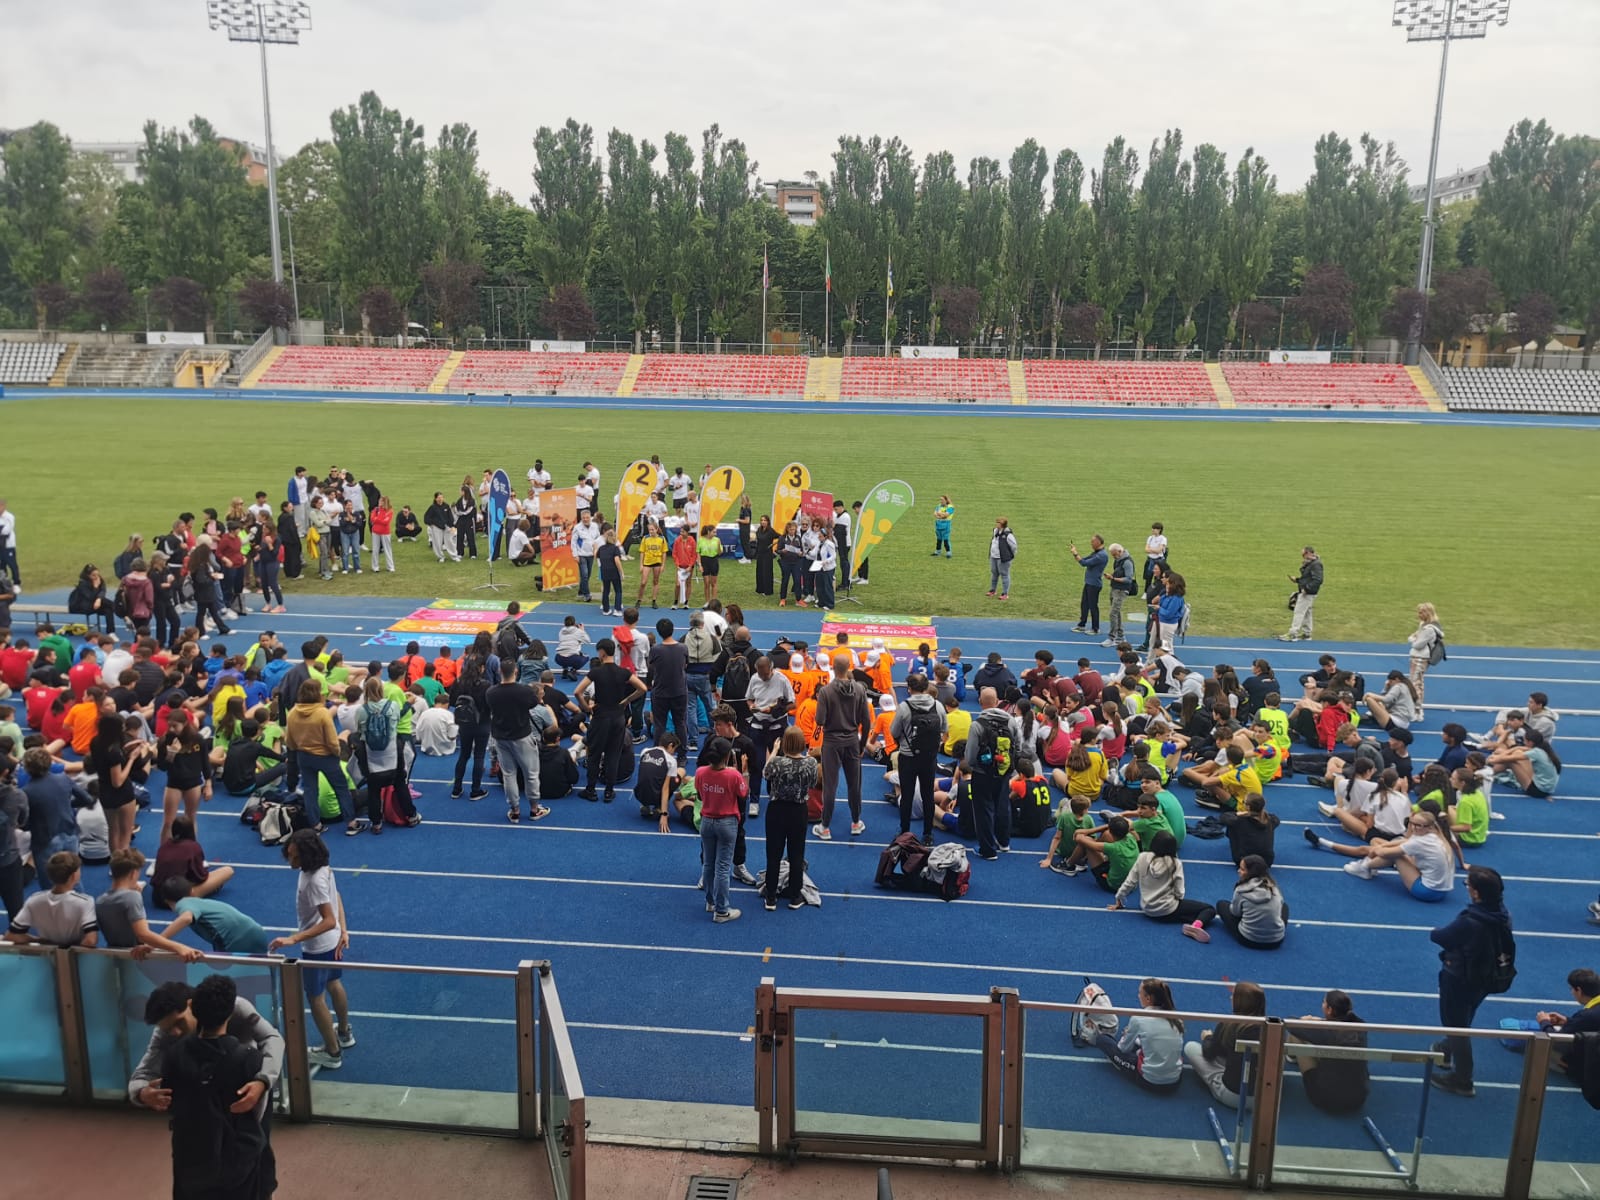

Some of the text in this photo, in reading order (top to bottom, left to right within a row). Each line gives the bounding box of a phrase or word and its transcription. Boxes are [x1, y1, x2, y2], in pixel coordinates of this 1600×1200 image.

[635, 463, 650, 486] 2
[722, 469, 733, 490] 1
[789, 466, 802, 488] 3
[948, 669, 957, 683] 8
[792, 680, 802, 694] 13
[1269, 719, 1284, 736] 25
[1032, 785, 1050, 806] 13
